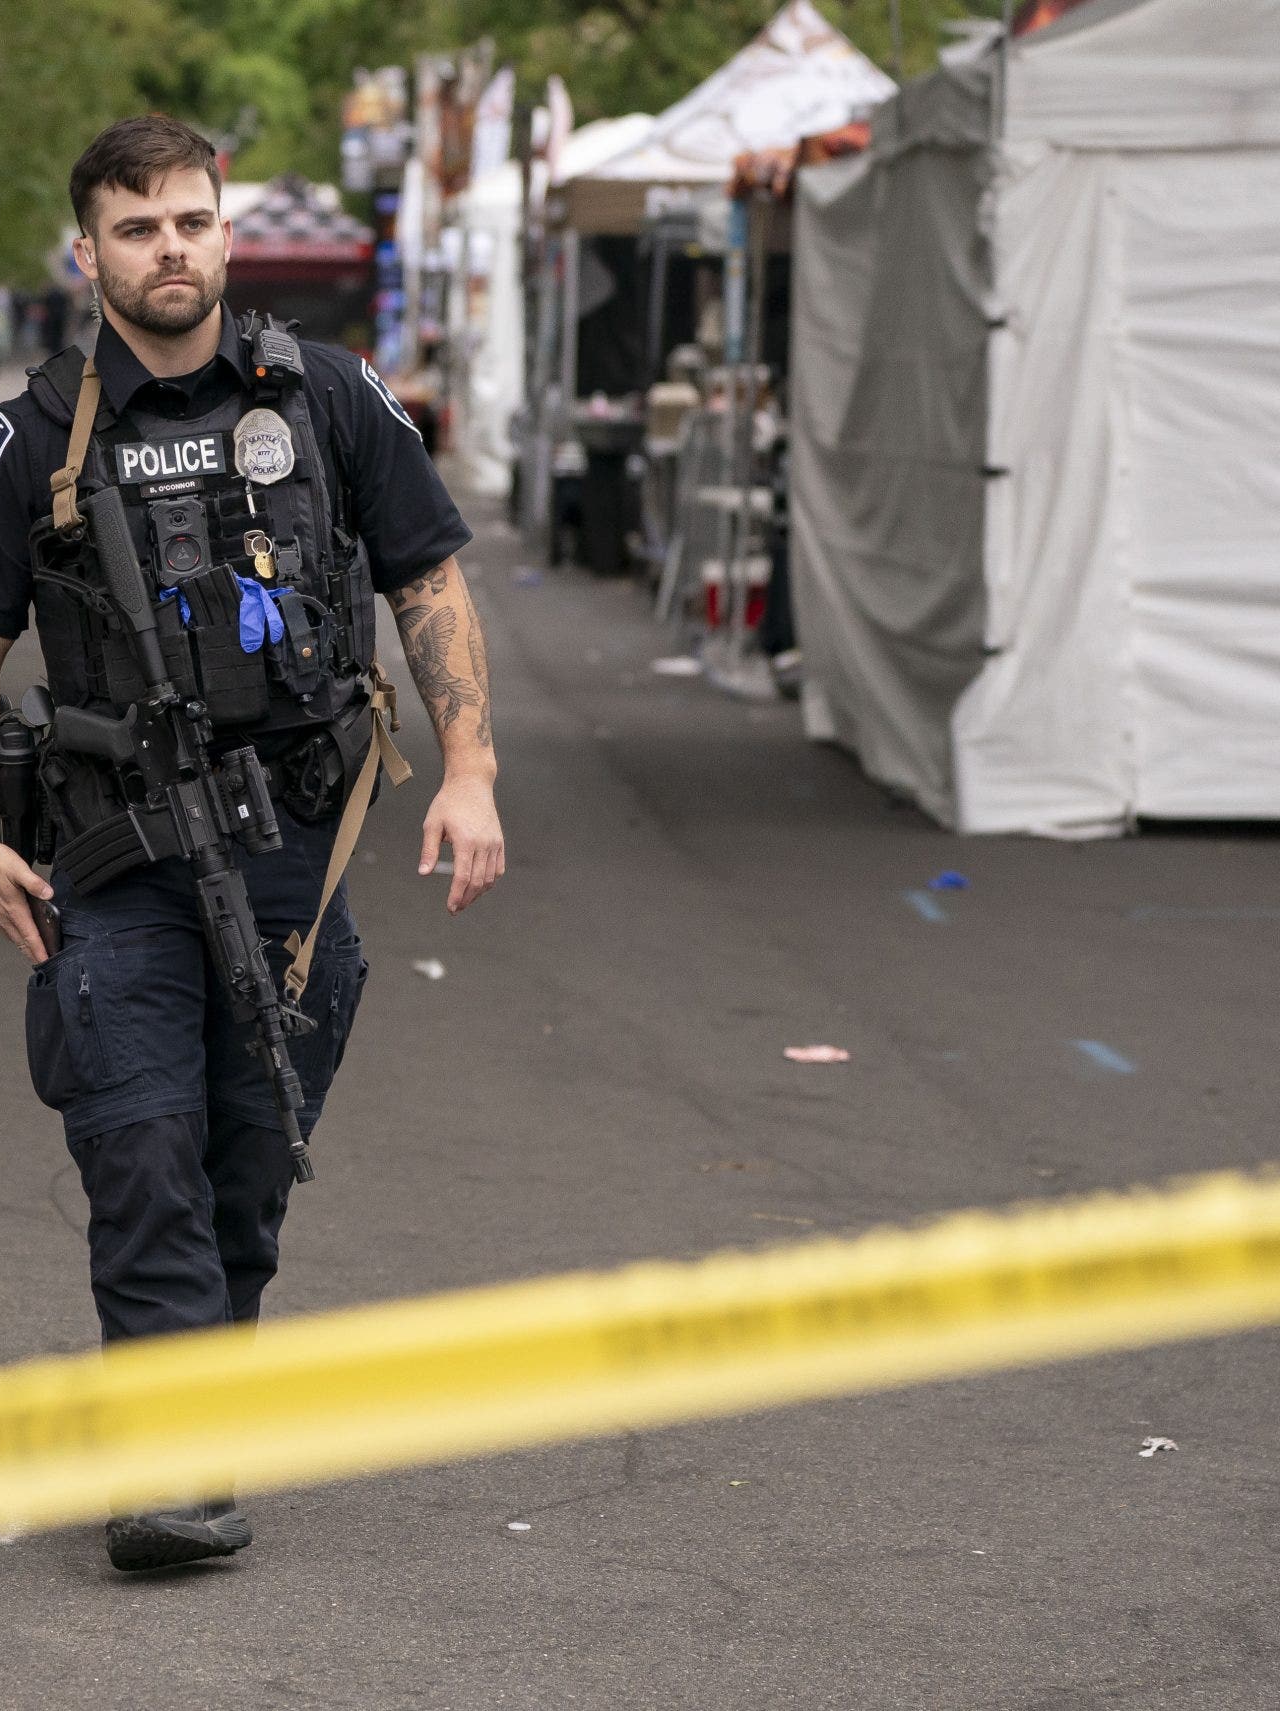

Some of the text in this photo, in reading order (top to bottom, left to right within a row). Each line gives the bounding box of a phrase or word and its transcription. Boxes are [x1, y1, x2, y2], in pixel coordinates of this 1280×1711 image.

[248, 434, 278, 445] SEATTLE
[123, 438, 219, 478] POLICE
[252, 465, 279, 474] POLICE
[158, 480, 196, 492] O'CONNOR
